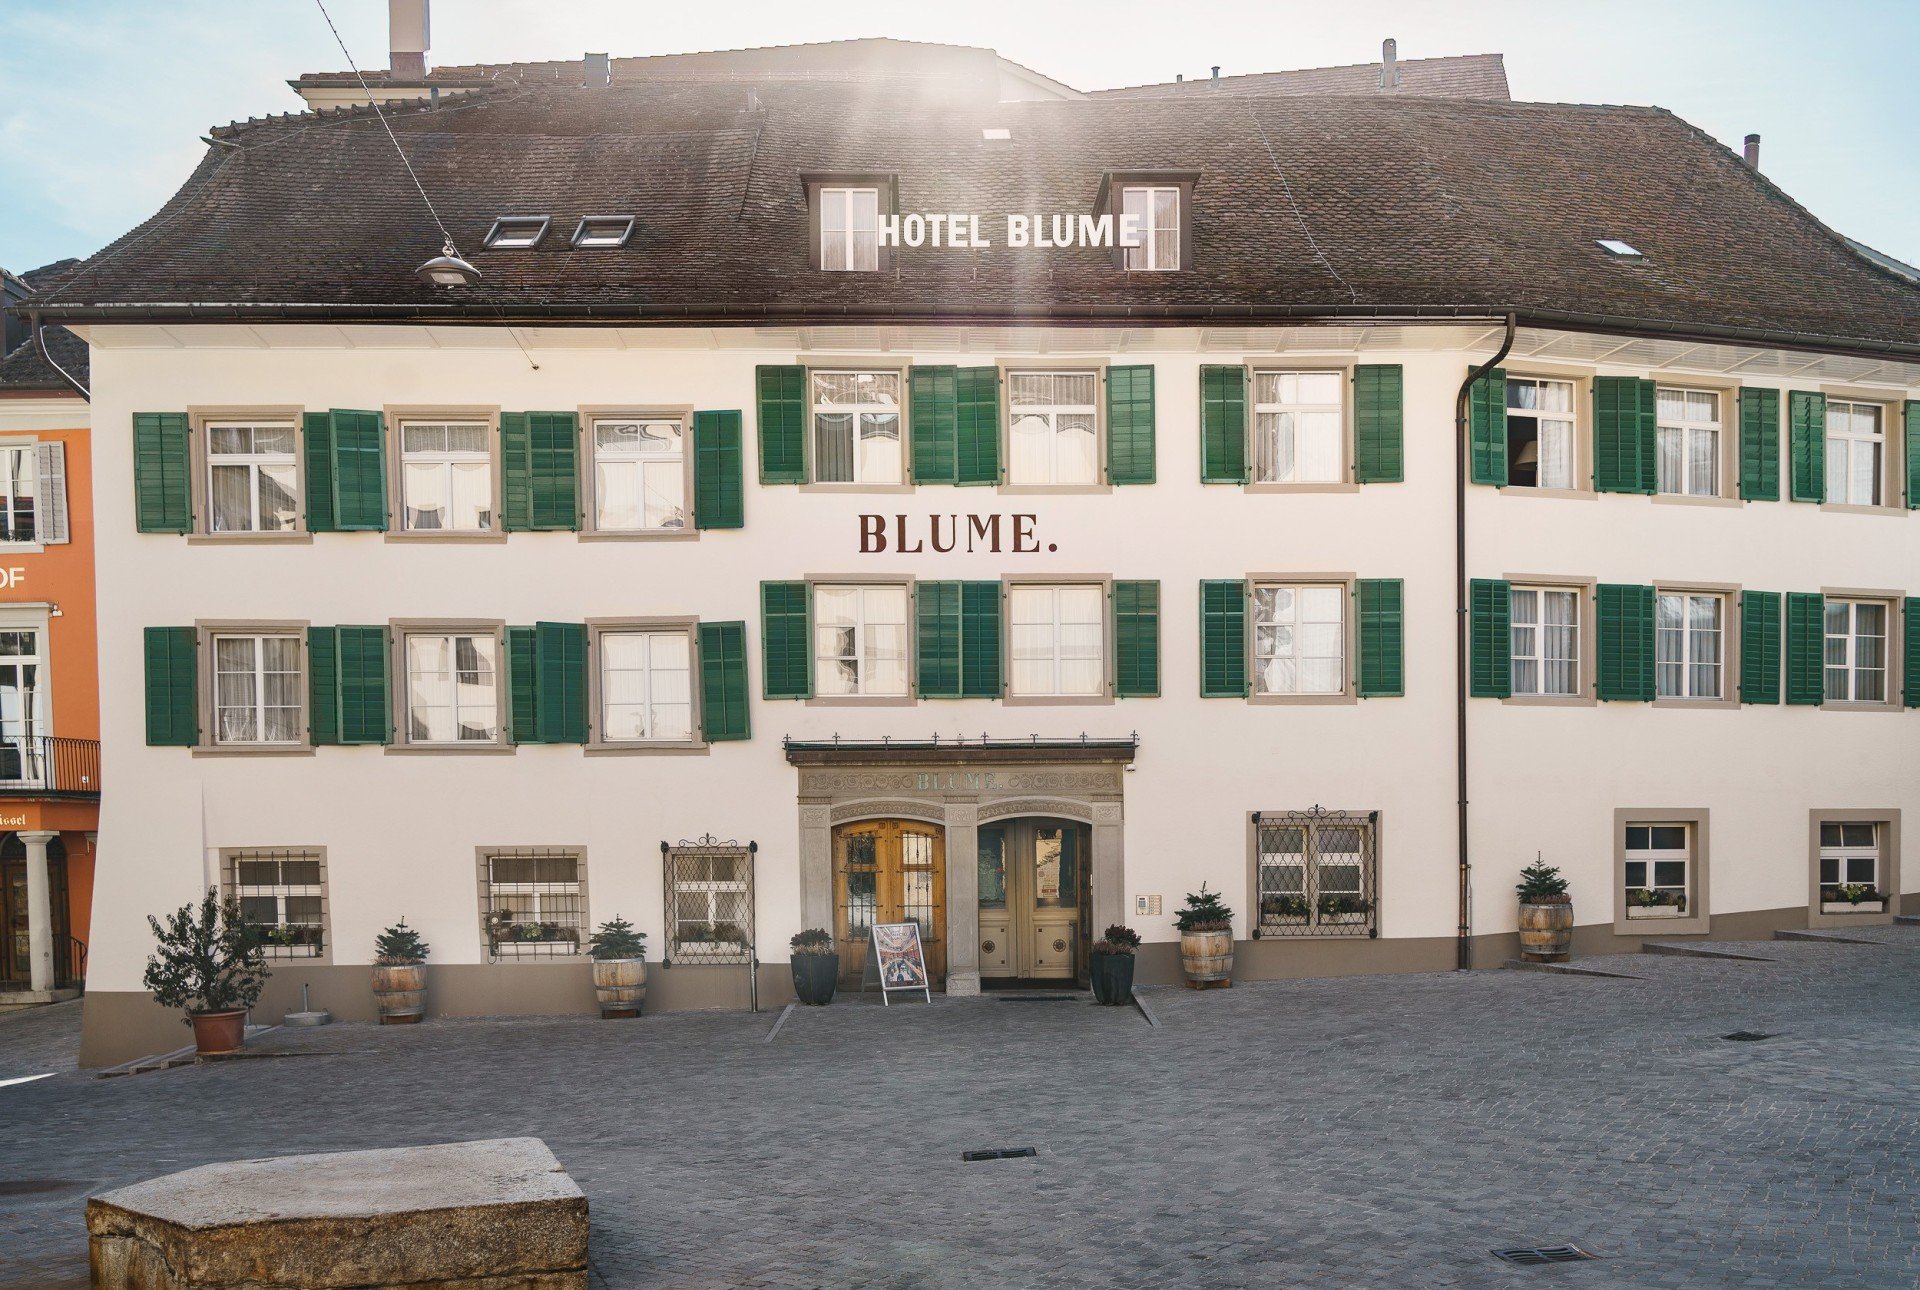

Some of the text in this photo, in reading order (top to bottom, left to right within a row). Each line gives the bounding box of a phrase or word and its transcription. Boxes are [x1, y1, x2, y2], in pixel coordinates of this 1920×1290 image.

[878, 213, 1140, 248] HOTEL BLUME
[858, 514, 1058, 553] BLUME.
